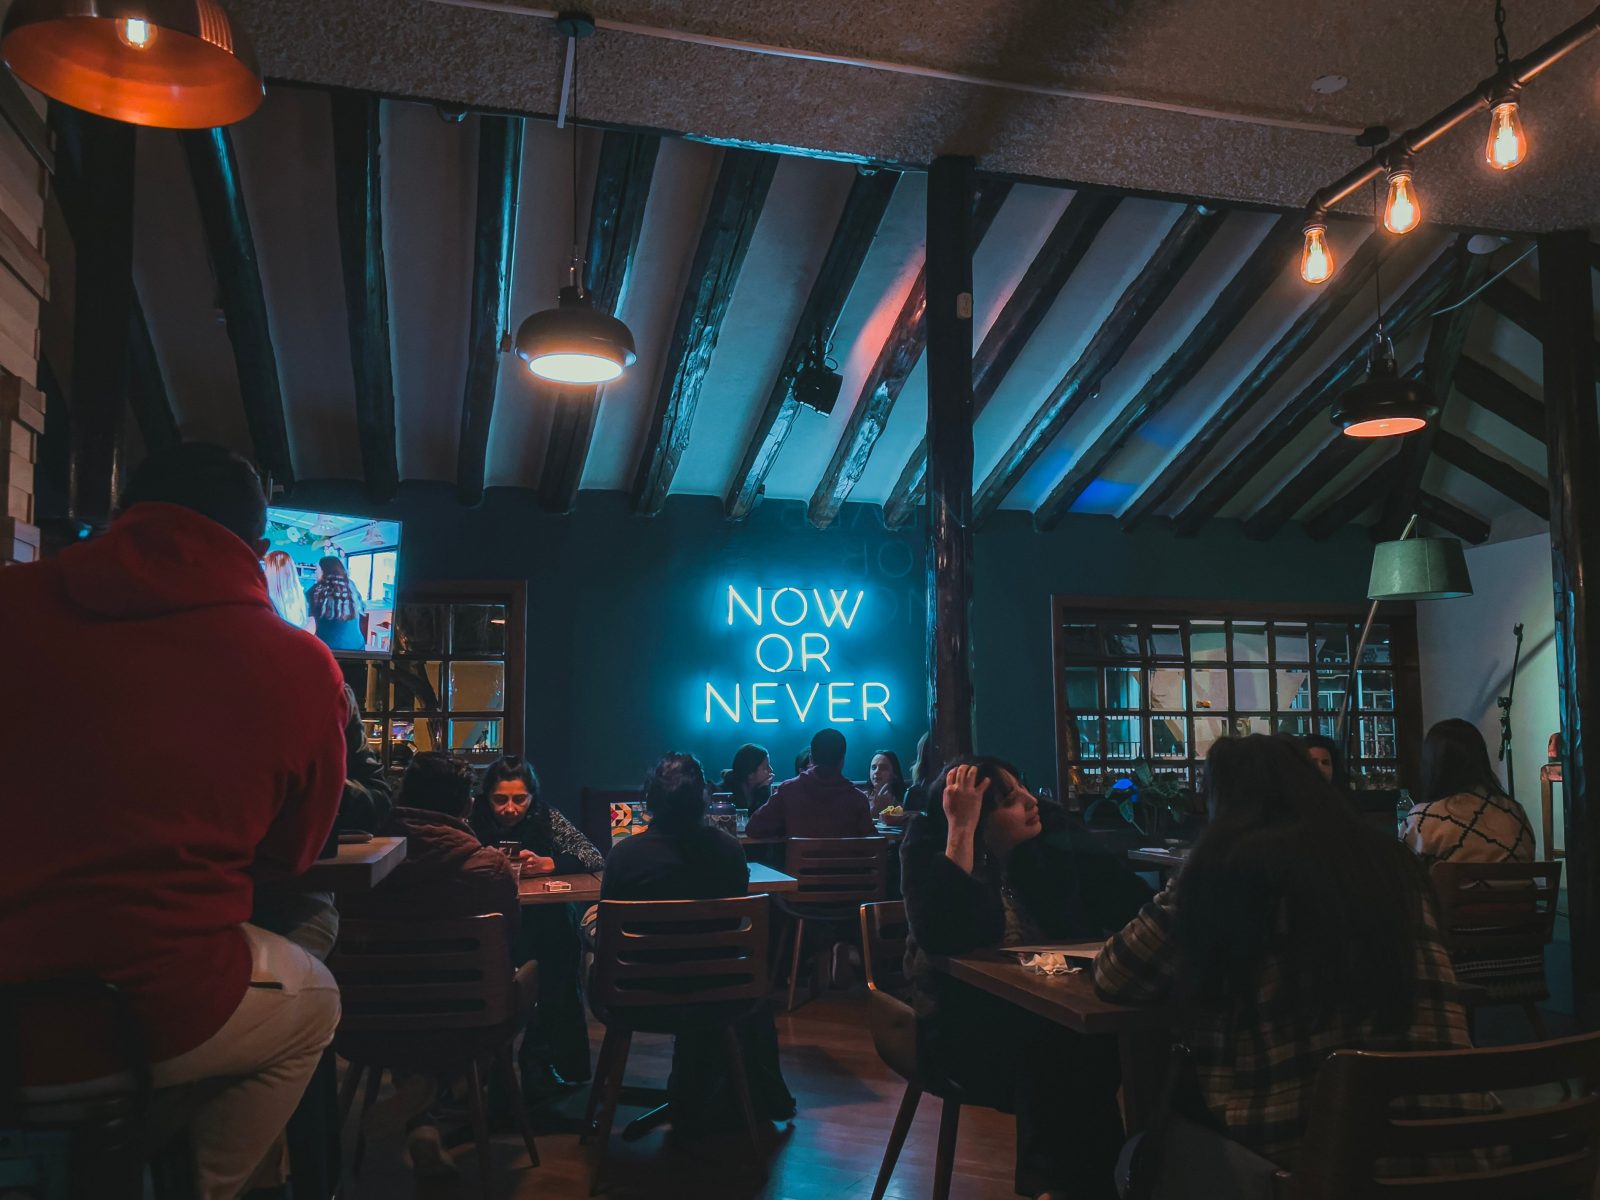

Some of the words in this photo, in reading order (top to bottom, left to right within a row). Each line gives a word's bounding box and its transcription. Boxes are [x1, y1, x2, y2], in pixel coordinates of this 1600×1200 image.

[727, 584, 864, 629] NOW
[756, 632, 831, 673] OR
[705, 682, 891, 723] NEVER
